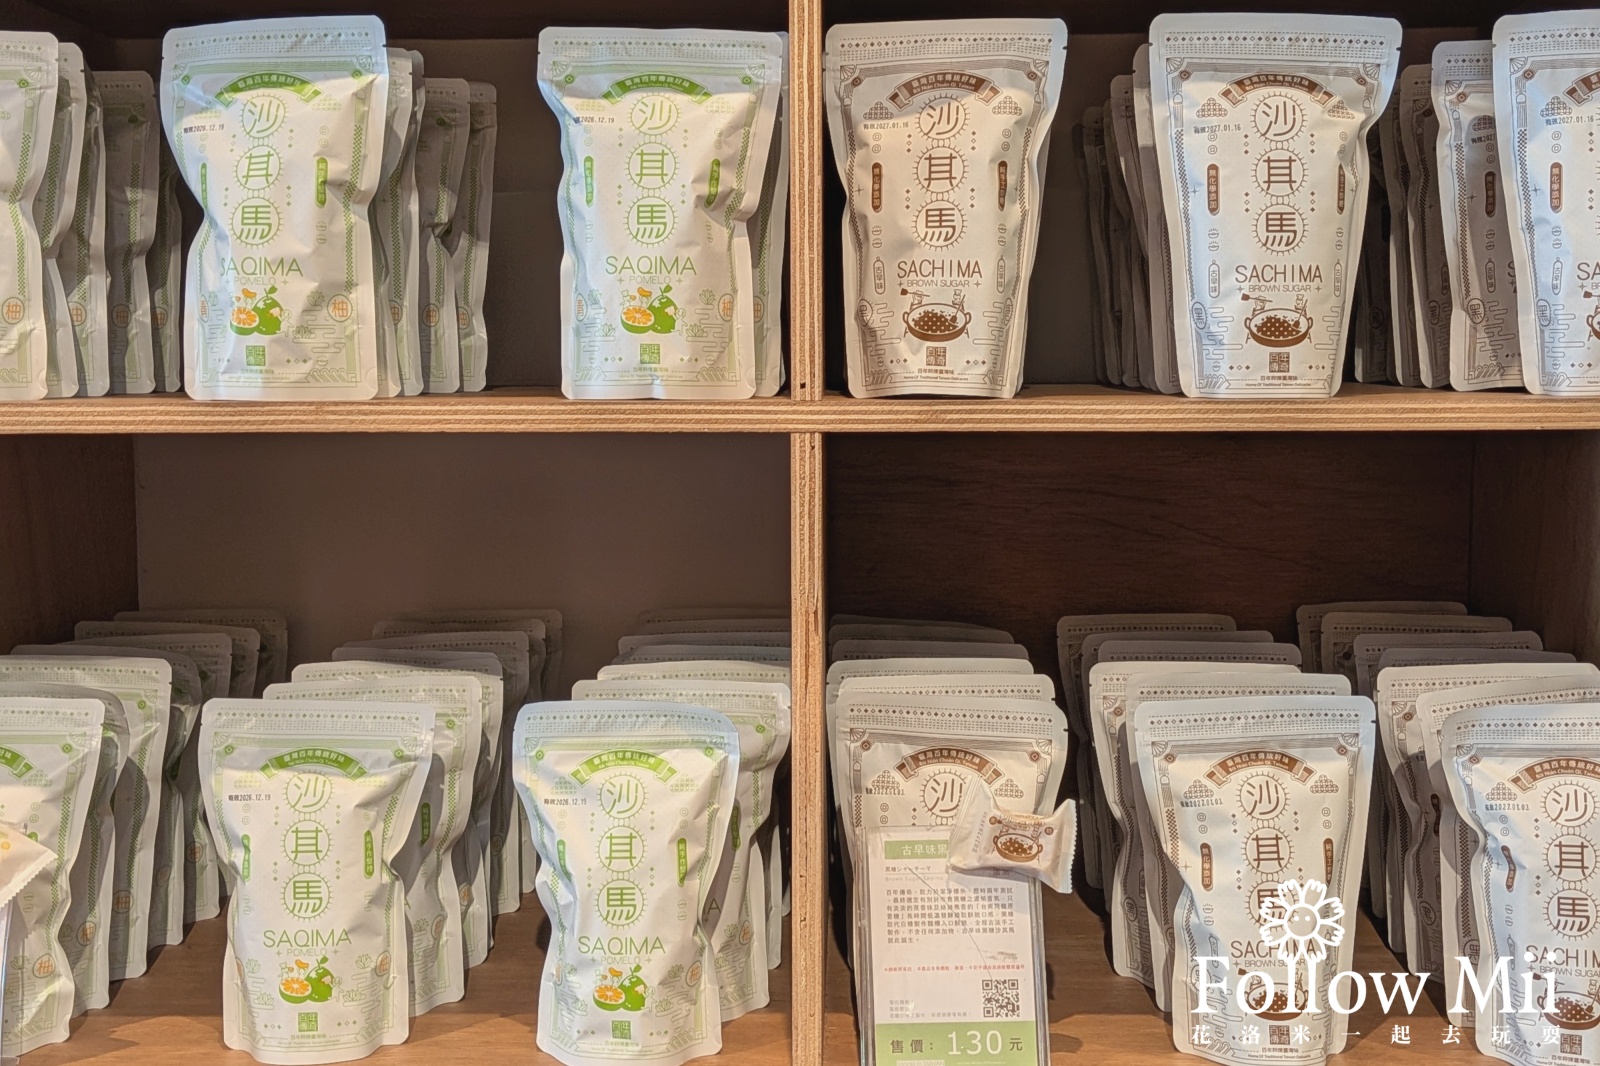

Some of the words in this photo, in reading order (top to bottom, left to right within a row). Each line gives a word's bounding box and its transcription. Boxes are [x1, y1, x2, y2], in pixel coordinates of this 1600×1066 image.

[911, 73, 976, 88] 臺灣百年傳統好味
[239, 100, 281, 240] 沙其馬
[634, 101, 672, 239] 沙其馬
[923, 102, 960, 242] 沙其馬
[1262, 101, 1297, 247] 沙其馬
[221, 256, 303, 277] SAQIMA
[605, 256, 696, 275] SAQIMA
[897, 259, 982, 279] SACHIMA
[1235, 264, 1322, 284] SACHIMA
[234, 277, 276, 285] POMELO
[629, 276, 671, 285] POMELO
[907, 279, 938, 288] BROWN
[939, 279, 970, 288] SUGAR
[1248, 284, 1280, 293] BROWN
[1282, 284, 1311, 293] SUGAR
[331, 299, 348, 318] 柚
[291, 776, 327, 914] 沙其馬
[605, 779, 639, 921] 沙其馬
[1552, 789, 1591, 933] 沙其馬
[263, 928, 352, 948] SAQIMA
[578, 936, 666, 954] SAQIMA
[286, 948, 327, 957] POMELO
[601, 956, 641, 965] POMELO
[1245, 960, 1276, 968] BROWN
[1540, 965, 1573, 976] BROWN
[890, 1039, 934, 1054] 售價：
[948, 1030, 1003, 1056] 130
[1009, 1037, 1023, 1052] 元
